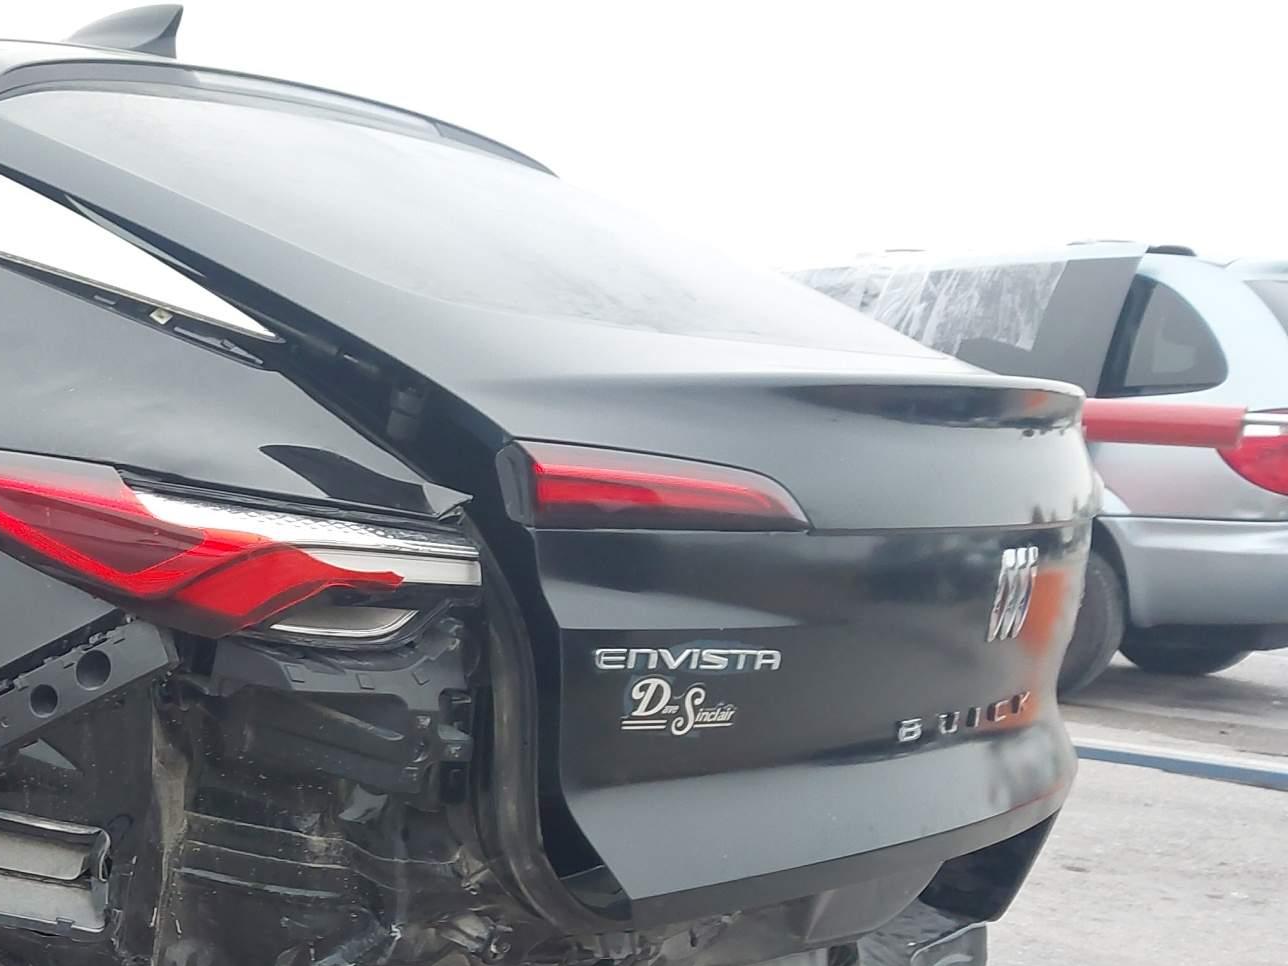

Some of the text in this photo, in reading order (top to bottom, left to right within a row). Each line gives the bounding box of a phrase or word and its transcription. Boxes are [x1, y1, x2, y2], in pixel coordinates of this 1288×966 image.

[595, 648, 782, 671] ENVISTA
[671, 687, 736, 736] Sinclair
[896, 691, 1032, 743] BUICK
